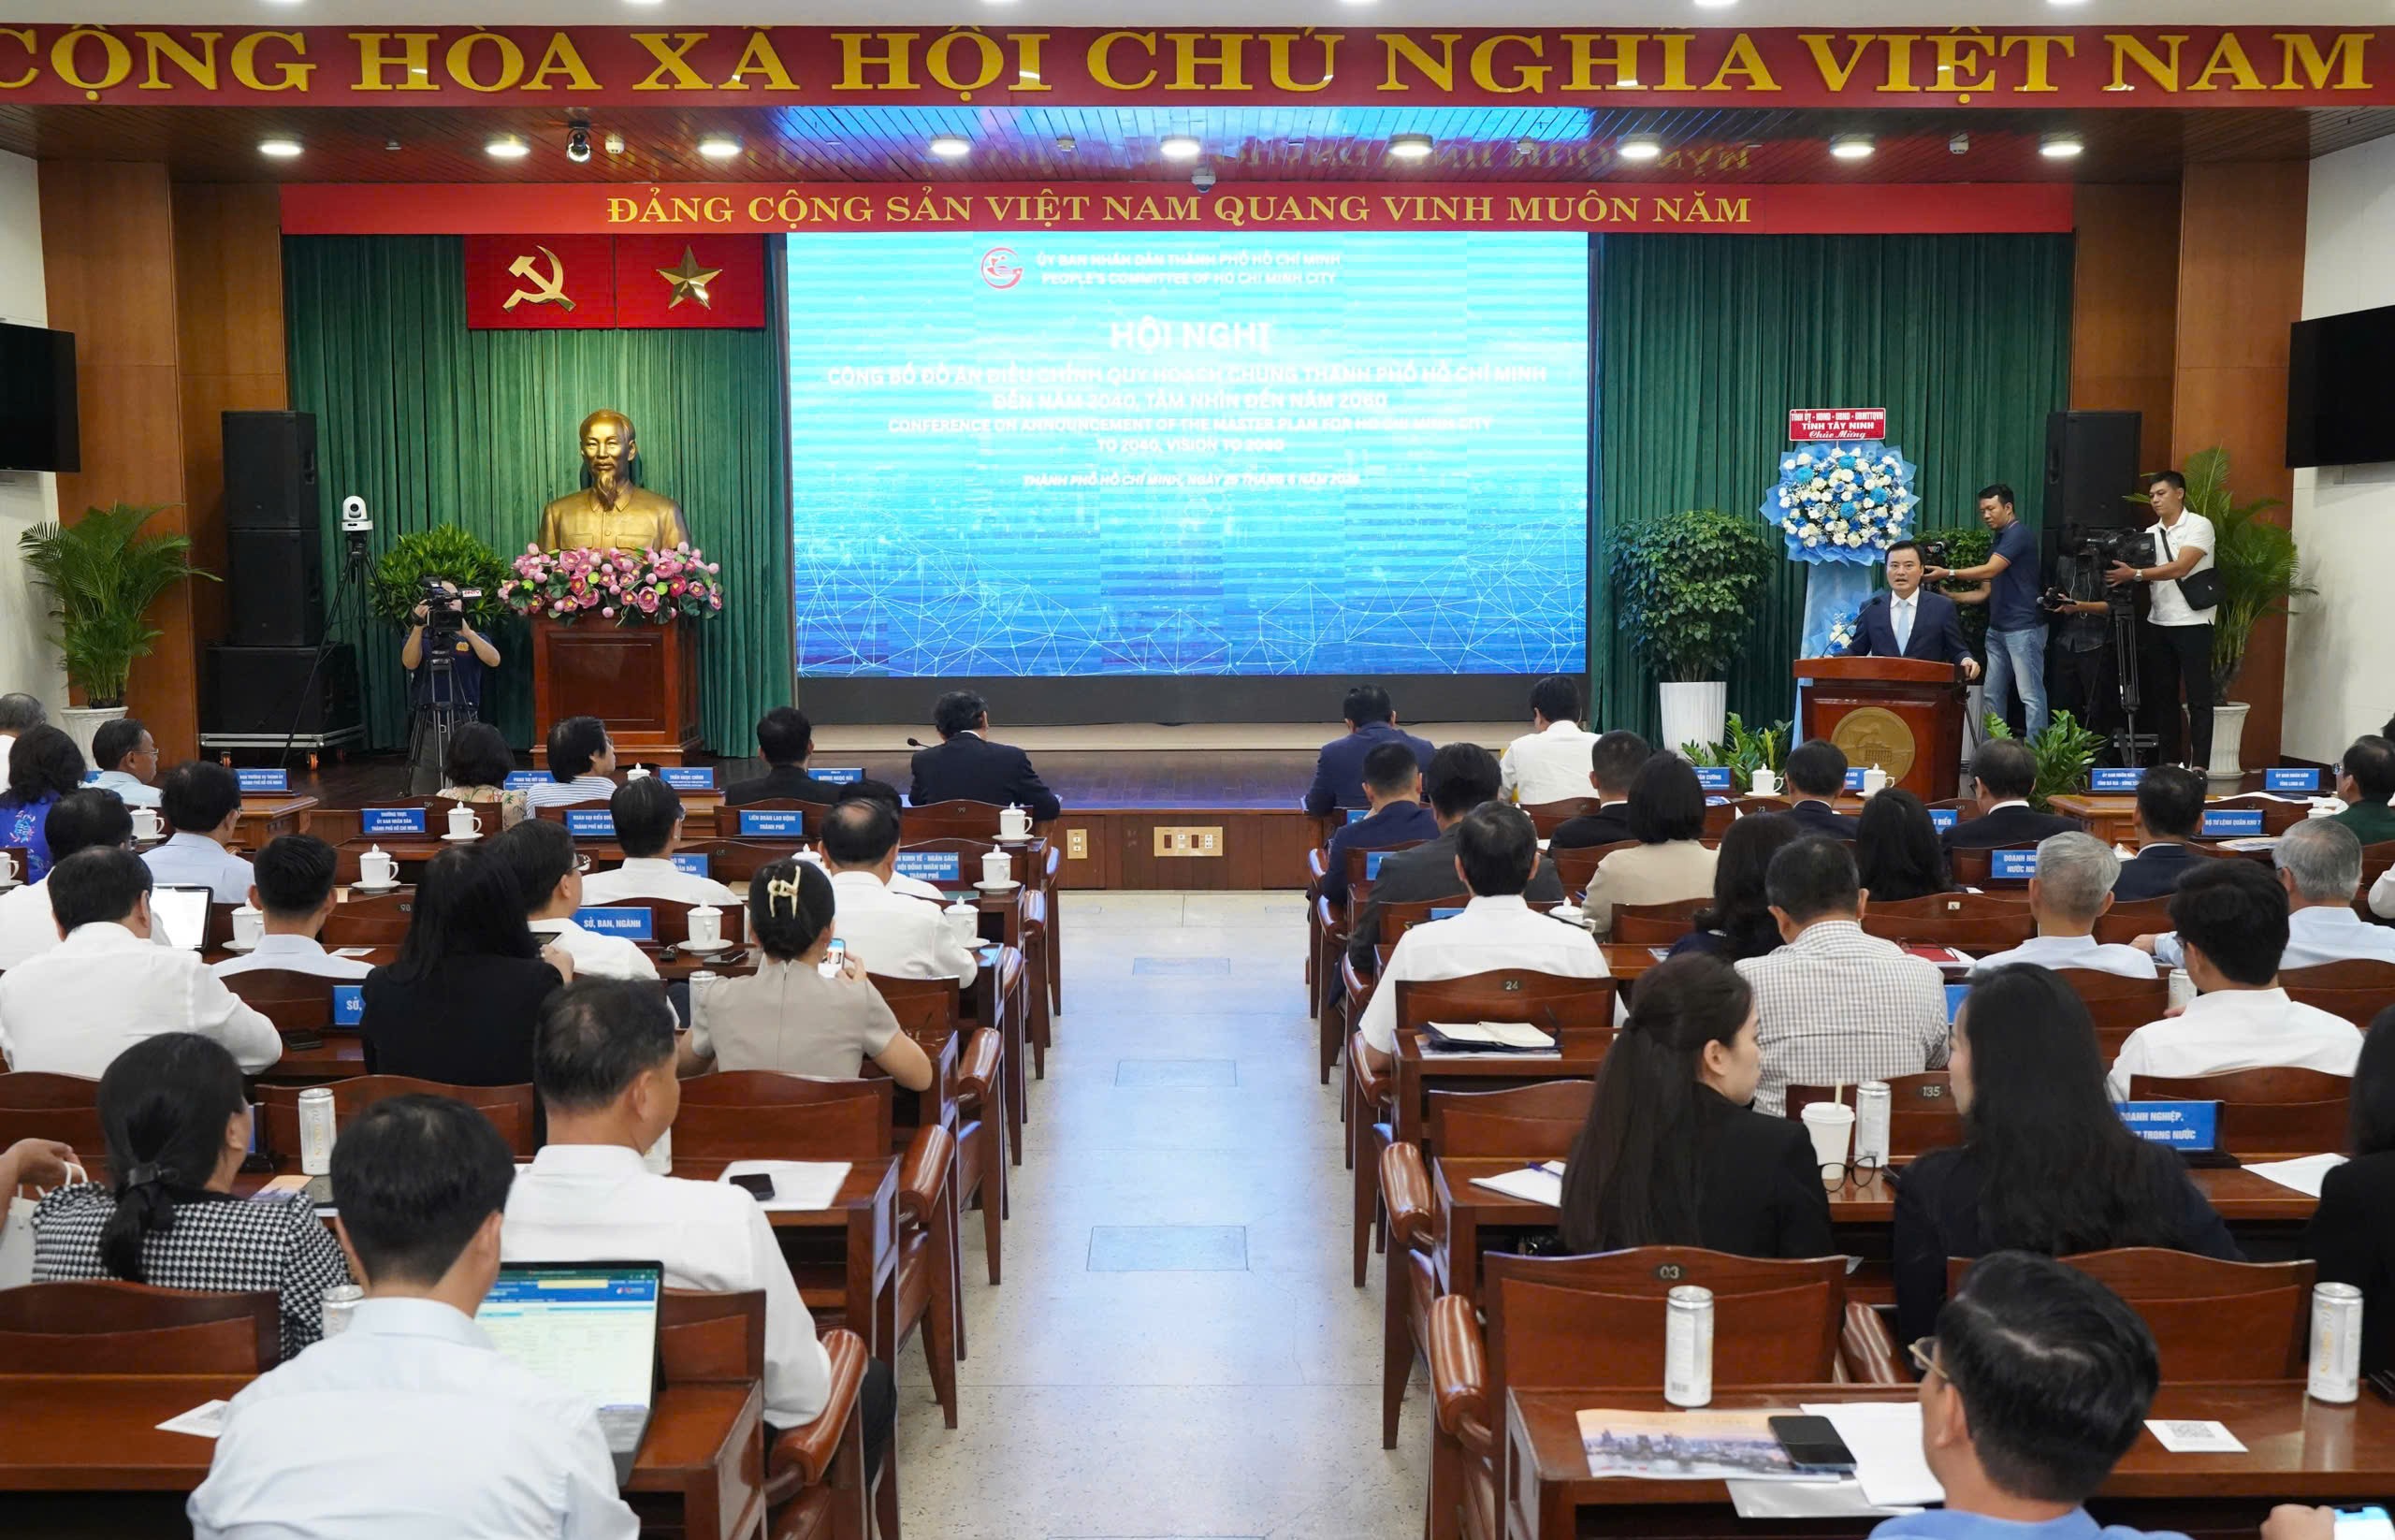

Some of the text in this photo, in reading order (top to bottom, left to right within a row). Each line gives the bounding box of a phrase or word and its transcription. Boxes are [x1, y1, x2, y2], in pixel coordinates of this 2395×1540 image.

[350, 25, 603, 92] HÒA
[631, 25, 801, 91] XÃ
[832, 25, 1052, 102] HỘI
[1087, 25, 1345, 92] CHỦ
[1376, 26, 1782, 94] NGHĨA
[1800, 26, 2075, 104] VIỆT
[2103, 34, 2373, 92] NAM
[607, 186, 1751, 230] ĐẢNG CỘNG SẢN VIỆT NAM QUANG VINH MUÔN NĂM
[1110, 314, 1270, 354] HỘI NGHỊ
[1495, 366, 1546, 382] MINH
[889, 418, 991, 432] CONFERENCE
[1022, 418, 1152, 431] ANNOUNCEMENT
[1155, 418, 1178, 431] OF
[1181, 417, 1209, 431] THE
[1214, 417, 1273, 430] MASTER
[1322, 417, 1351, 430] FOR
[1802, 420, 1824, 430] TỈNH
[1827, 421, 1846, 429] TÂY
[1097, 439, 1117, 452] TO
[1167, 438, 1217, 452] VISION
[584, 916, 642, 928] SỞ, BAN, NGÀNH
[1505, 981, 1519, 991] 24
[346, 995, 362, 1011] SỞ,
[1923, 1086, 1939, 1097] 135
[2143, 1130, 2170, 1140] TRONG
[2172, 1127, 2197, 1140] NƯỚC
[1660, 1266, 1680, 1280] 03
